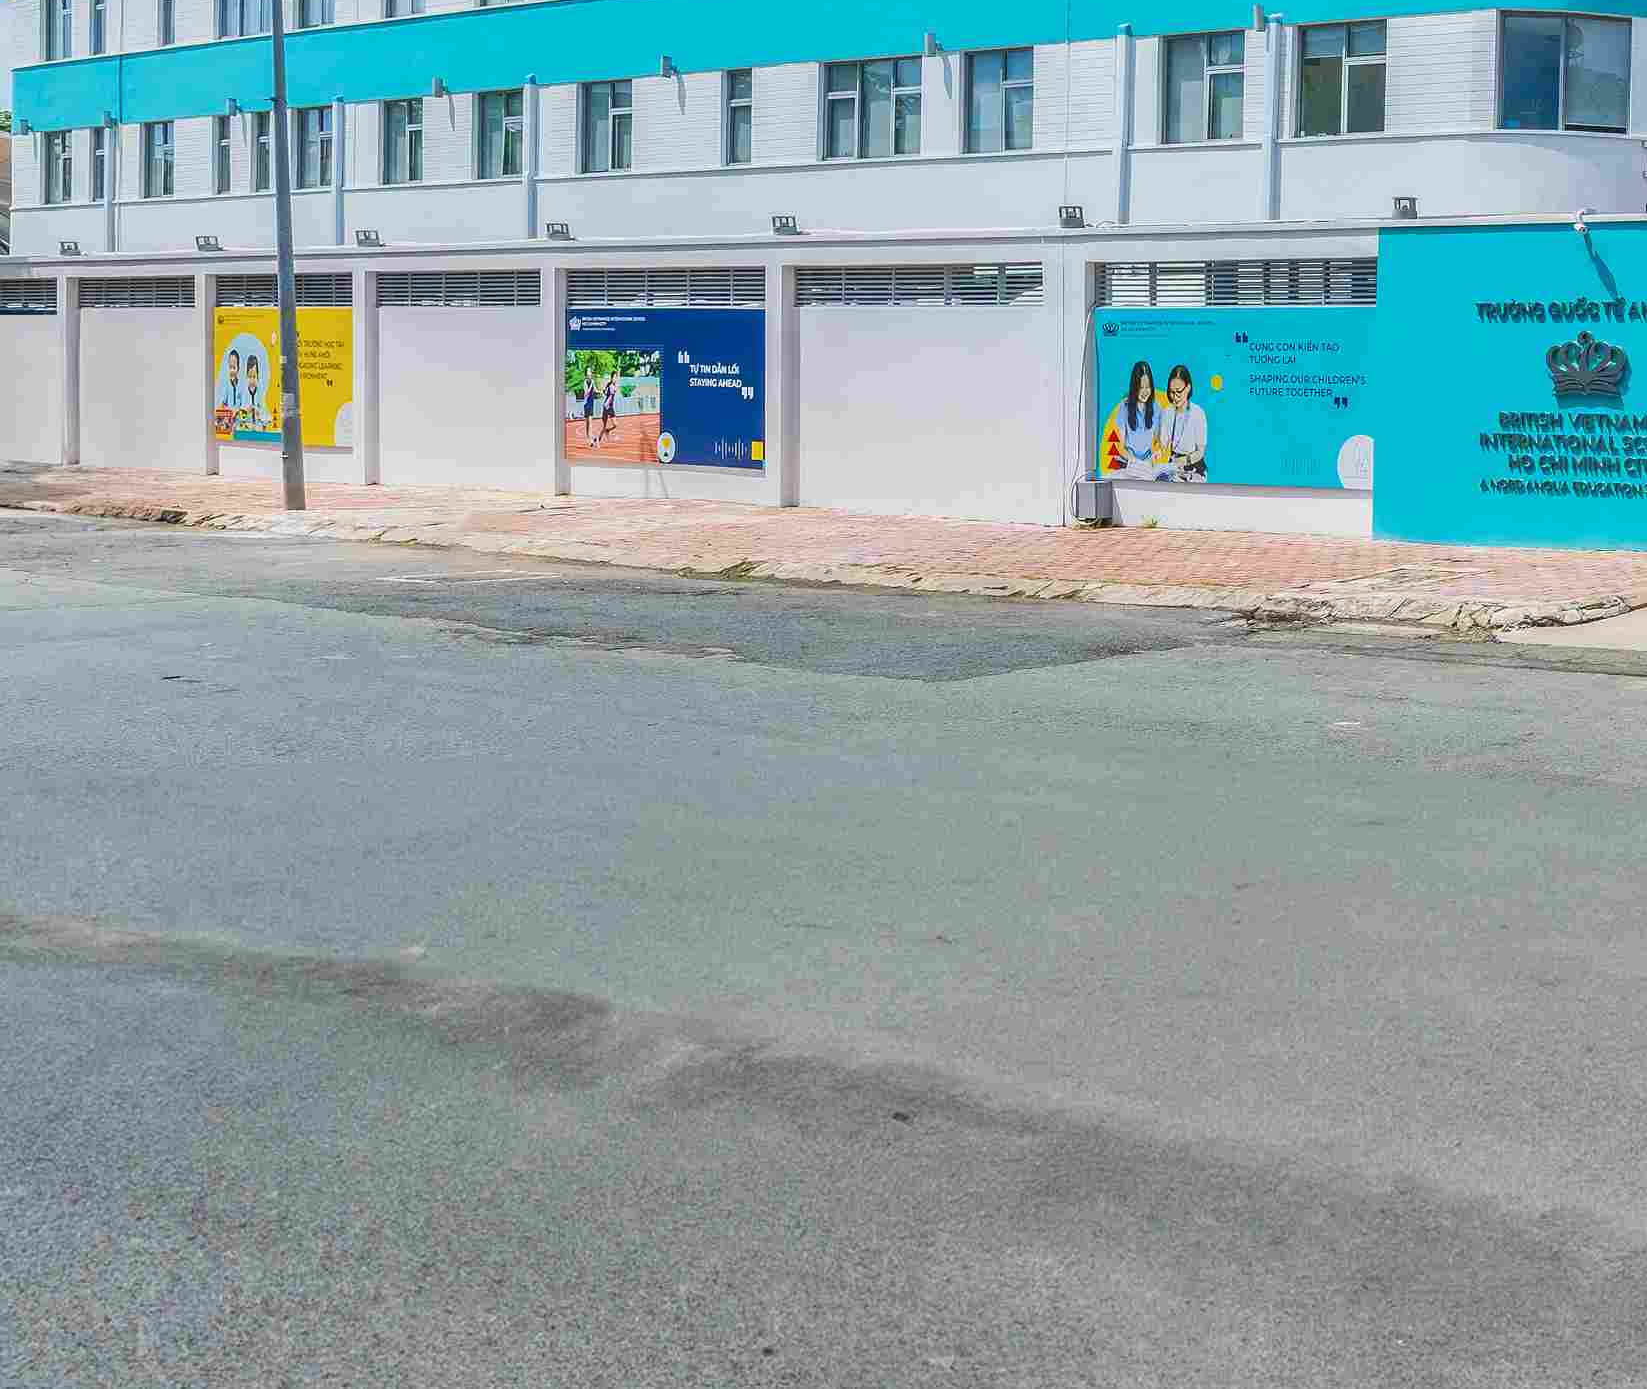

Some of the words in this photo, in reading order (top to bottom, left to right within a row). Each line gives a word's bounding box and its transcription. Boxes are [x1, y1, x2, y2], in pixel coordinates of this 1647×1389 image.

[1500, 412, 1563, 431] BRITISH
[1480, 432, 1619, 455] INTERNATIONAL
[1538, 455, 1568, 475] CHI
[1571, 456, 1621, 476] MINH
